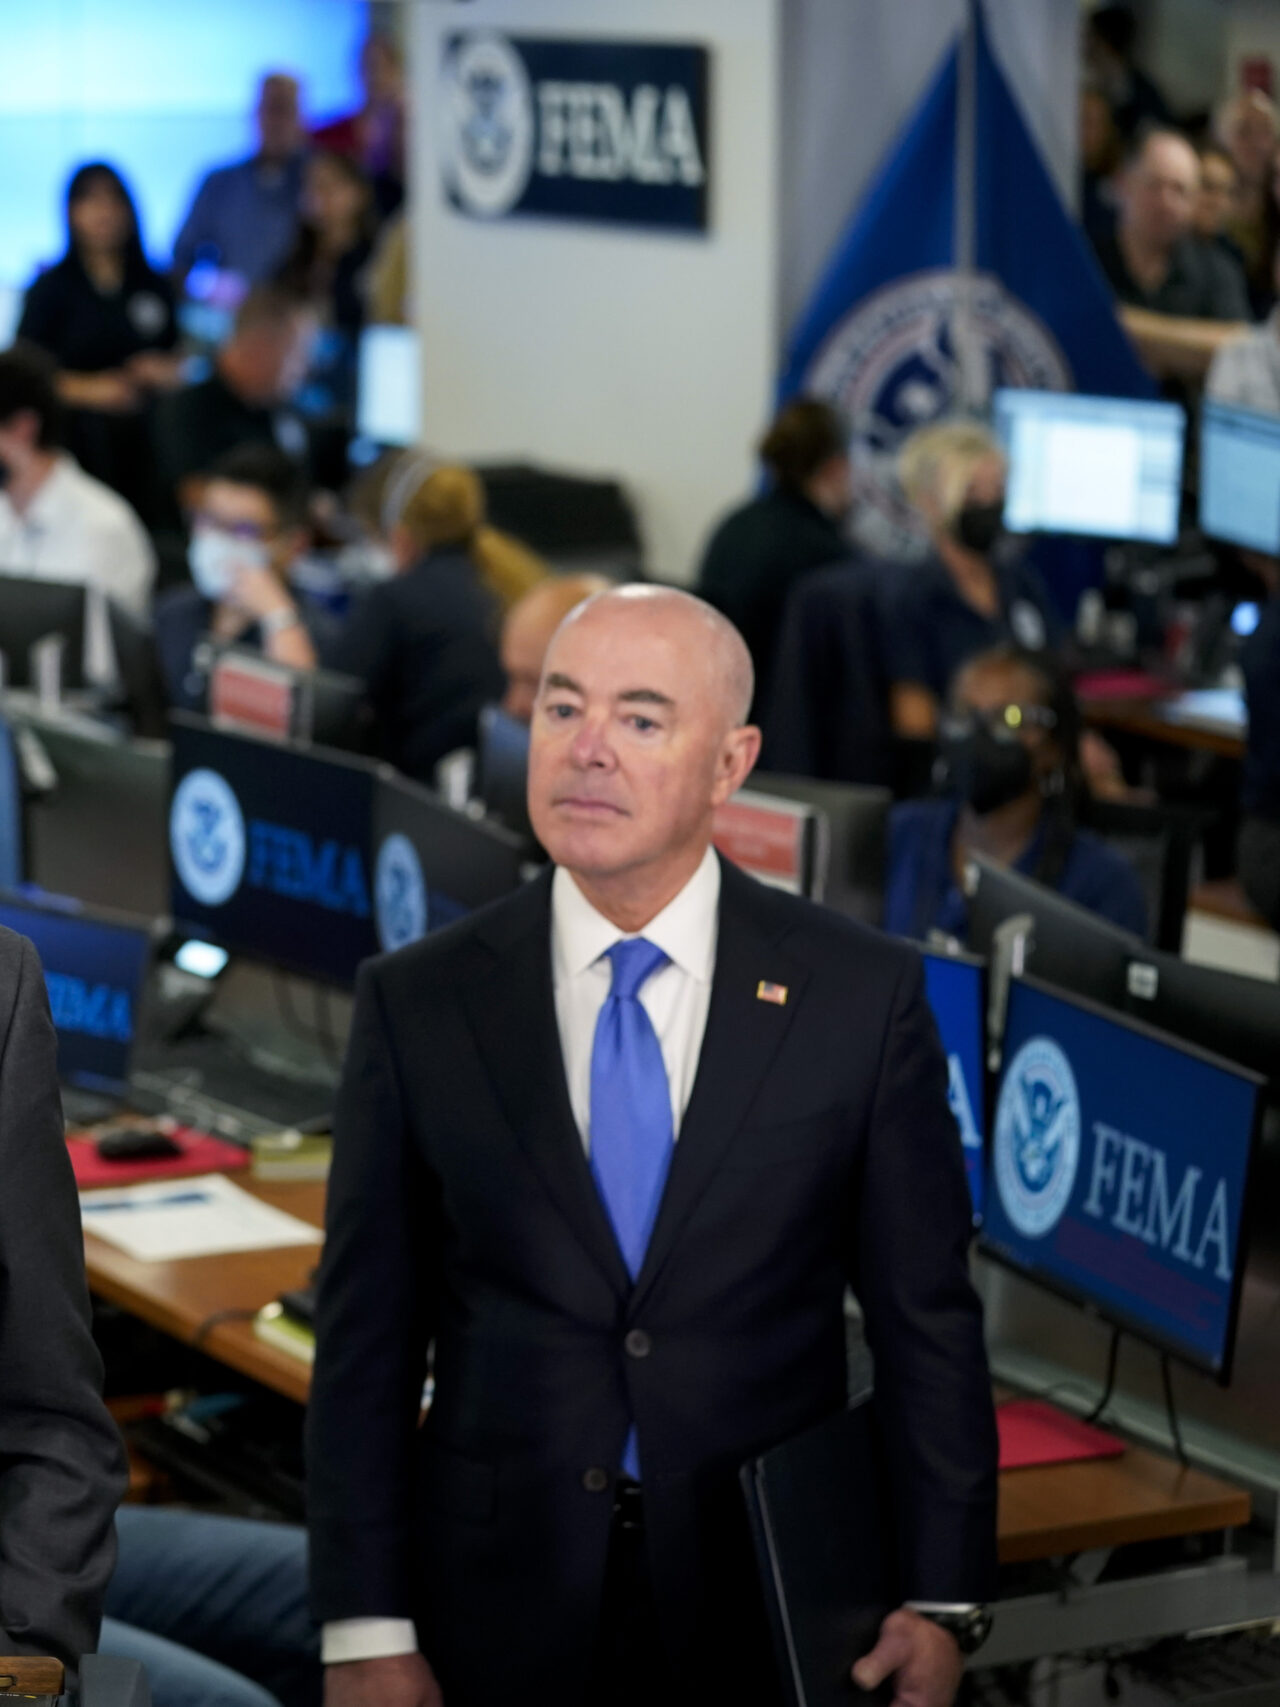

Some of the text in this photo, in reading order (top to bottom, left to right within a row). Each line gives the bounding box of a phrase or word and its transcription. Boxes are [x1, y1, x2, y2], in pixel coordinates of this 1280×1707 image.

[538, 79, 703, 186] FEMA
[249, 819, 369, 917] FEMA
[42, 970, 133, 1042] EMA
[1082, 1120, 1233, 1282] FEMA
